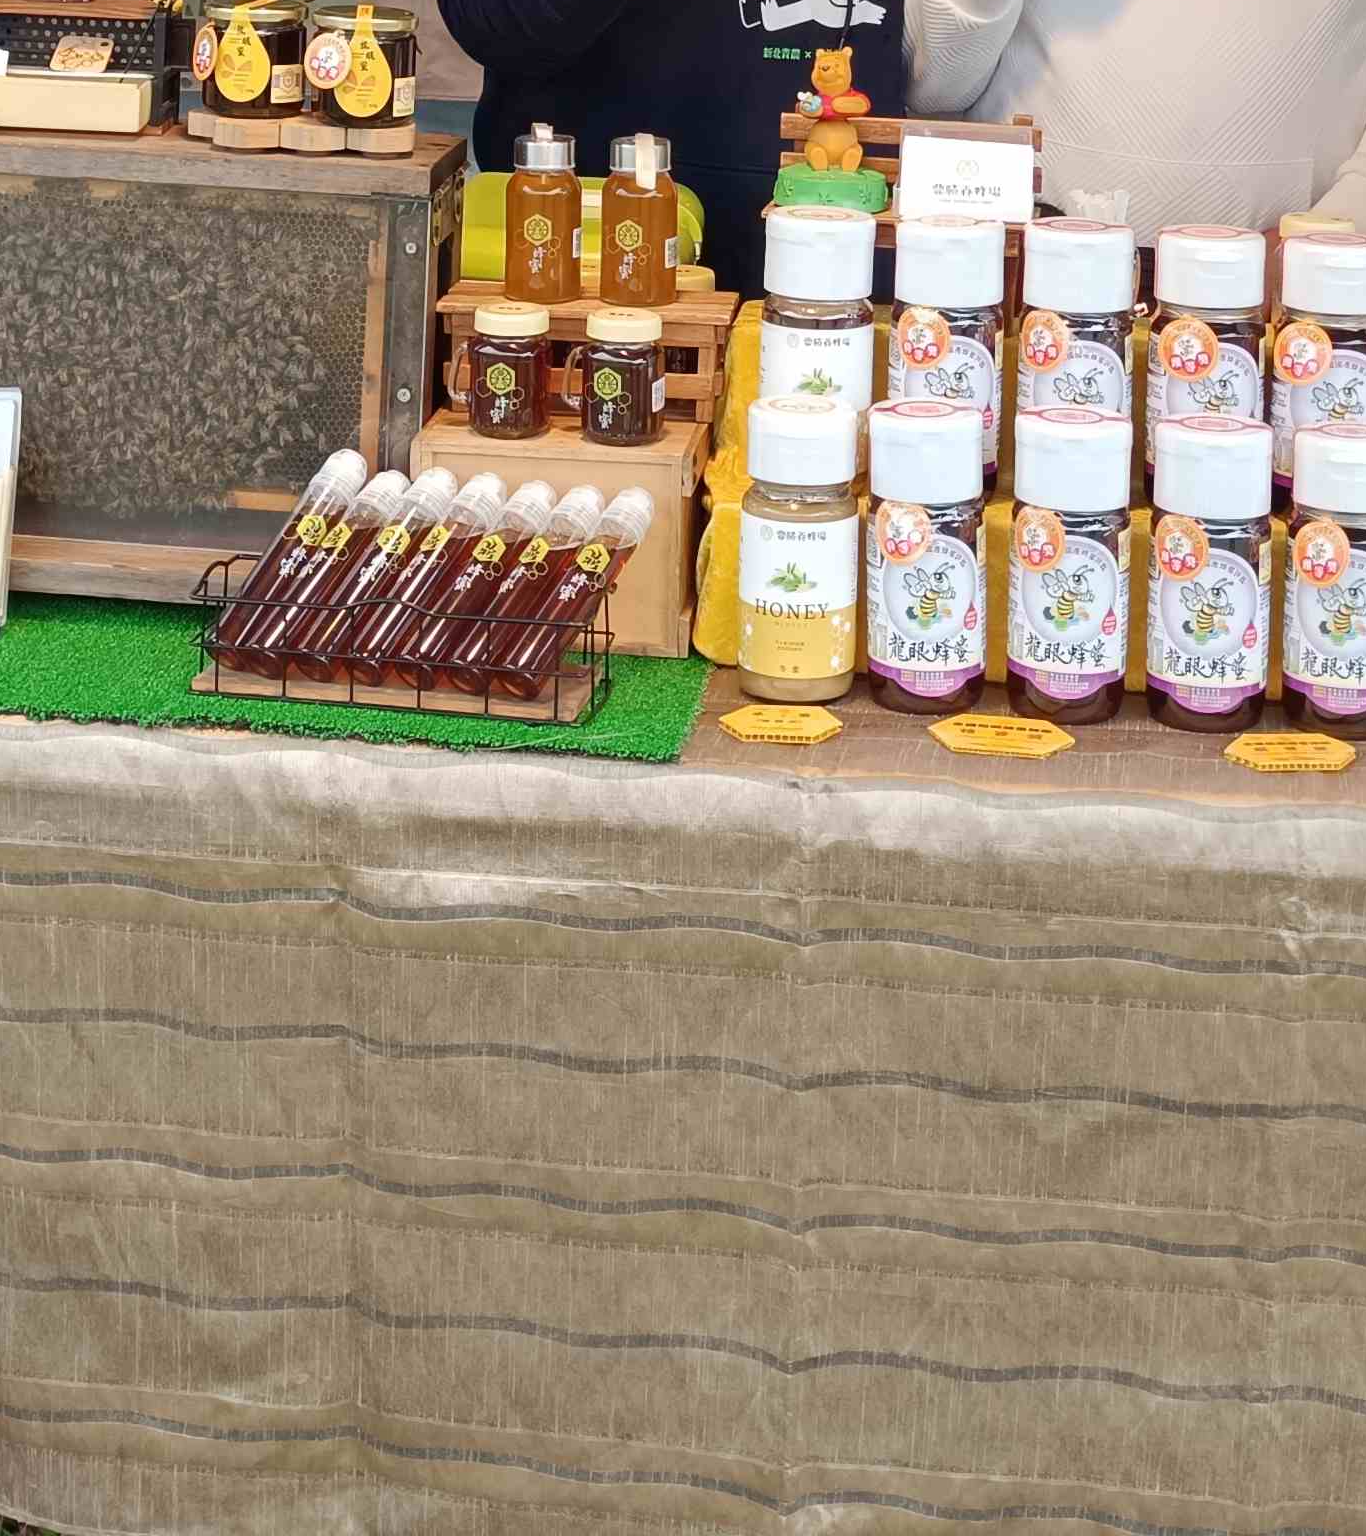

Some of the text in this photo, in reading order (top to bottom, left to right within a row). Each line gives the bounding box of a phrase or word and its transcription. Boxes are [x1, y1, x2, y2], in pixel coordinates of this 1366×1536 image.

[754, 598, 829, 620] HONEY
[888, 630, 973, 667] 龍眼蜂蜜
[1025, 631, 1111, 670] 龍眼蜂蜜
[1164, 646, 1253, 684] 龍眼蜂蜜
